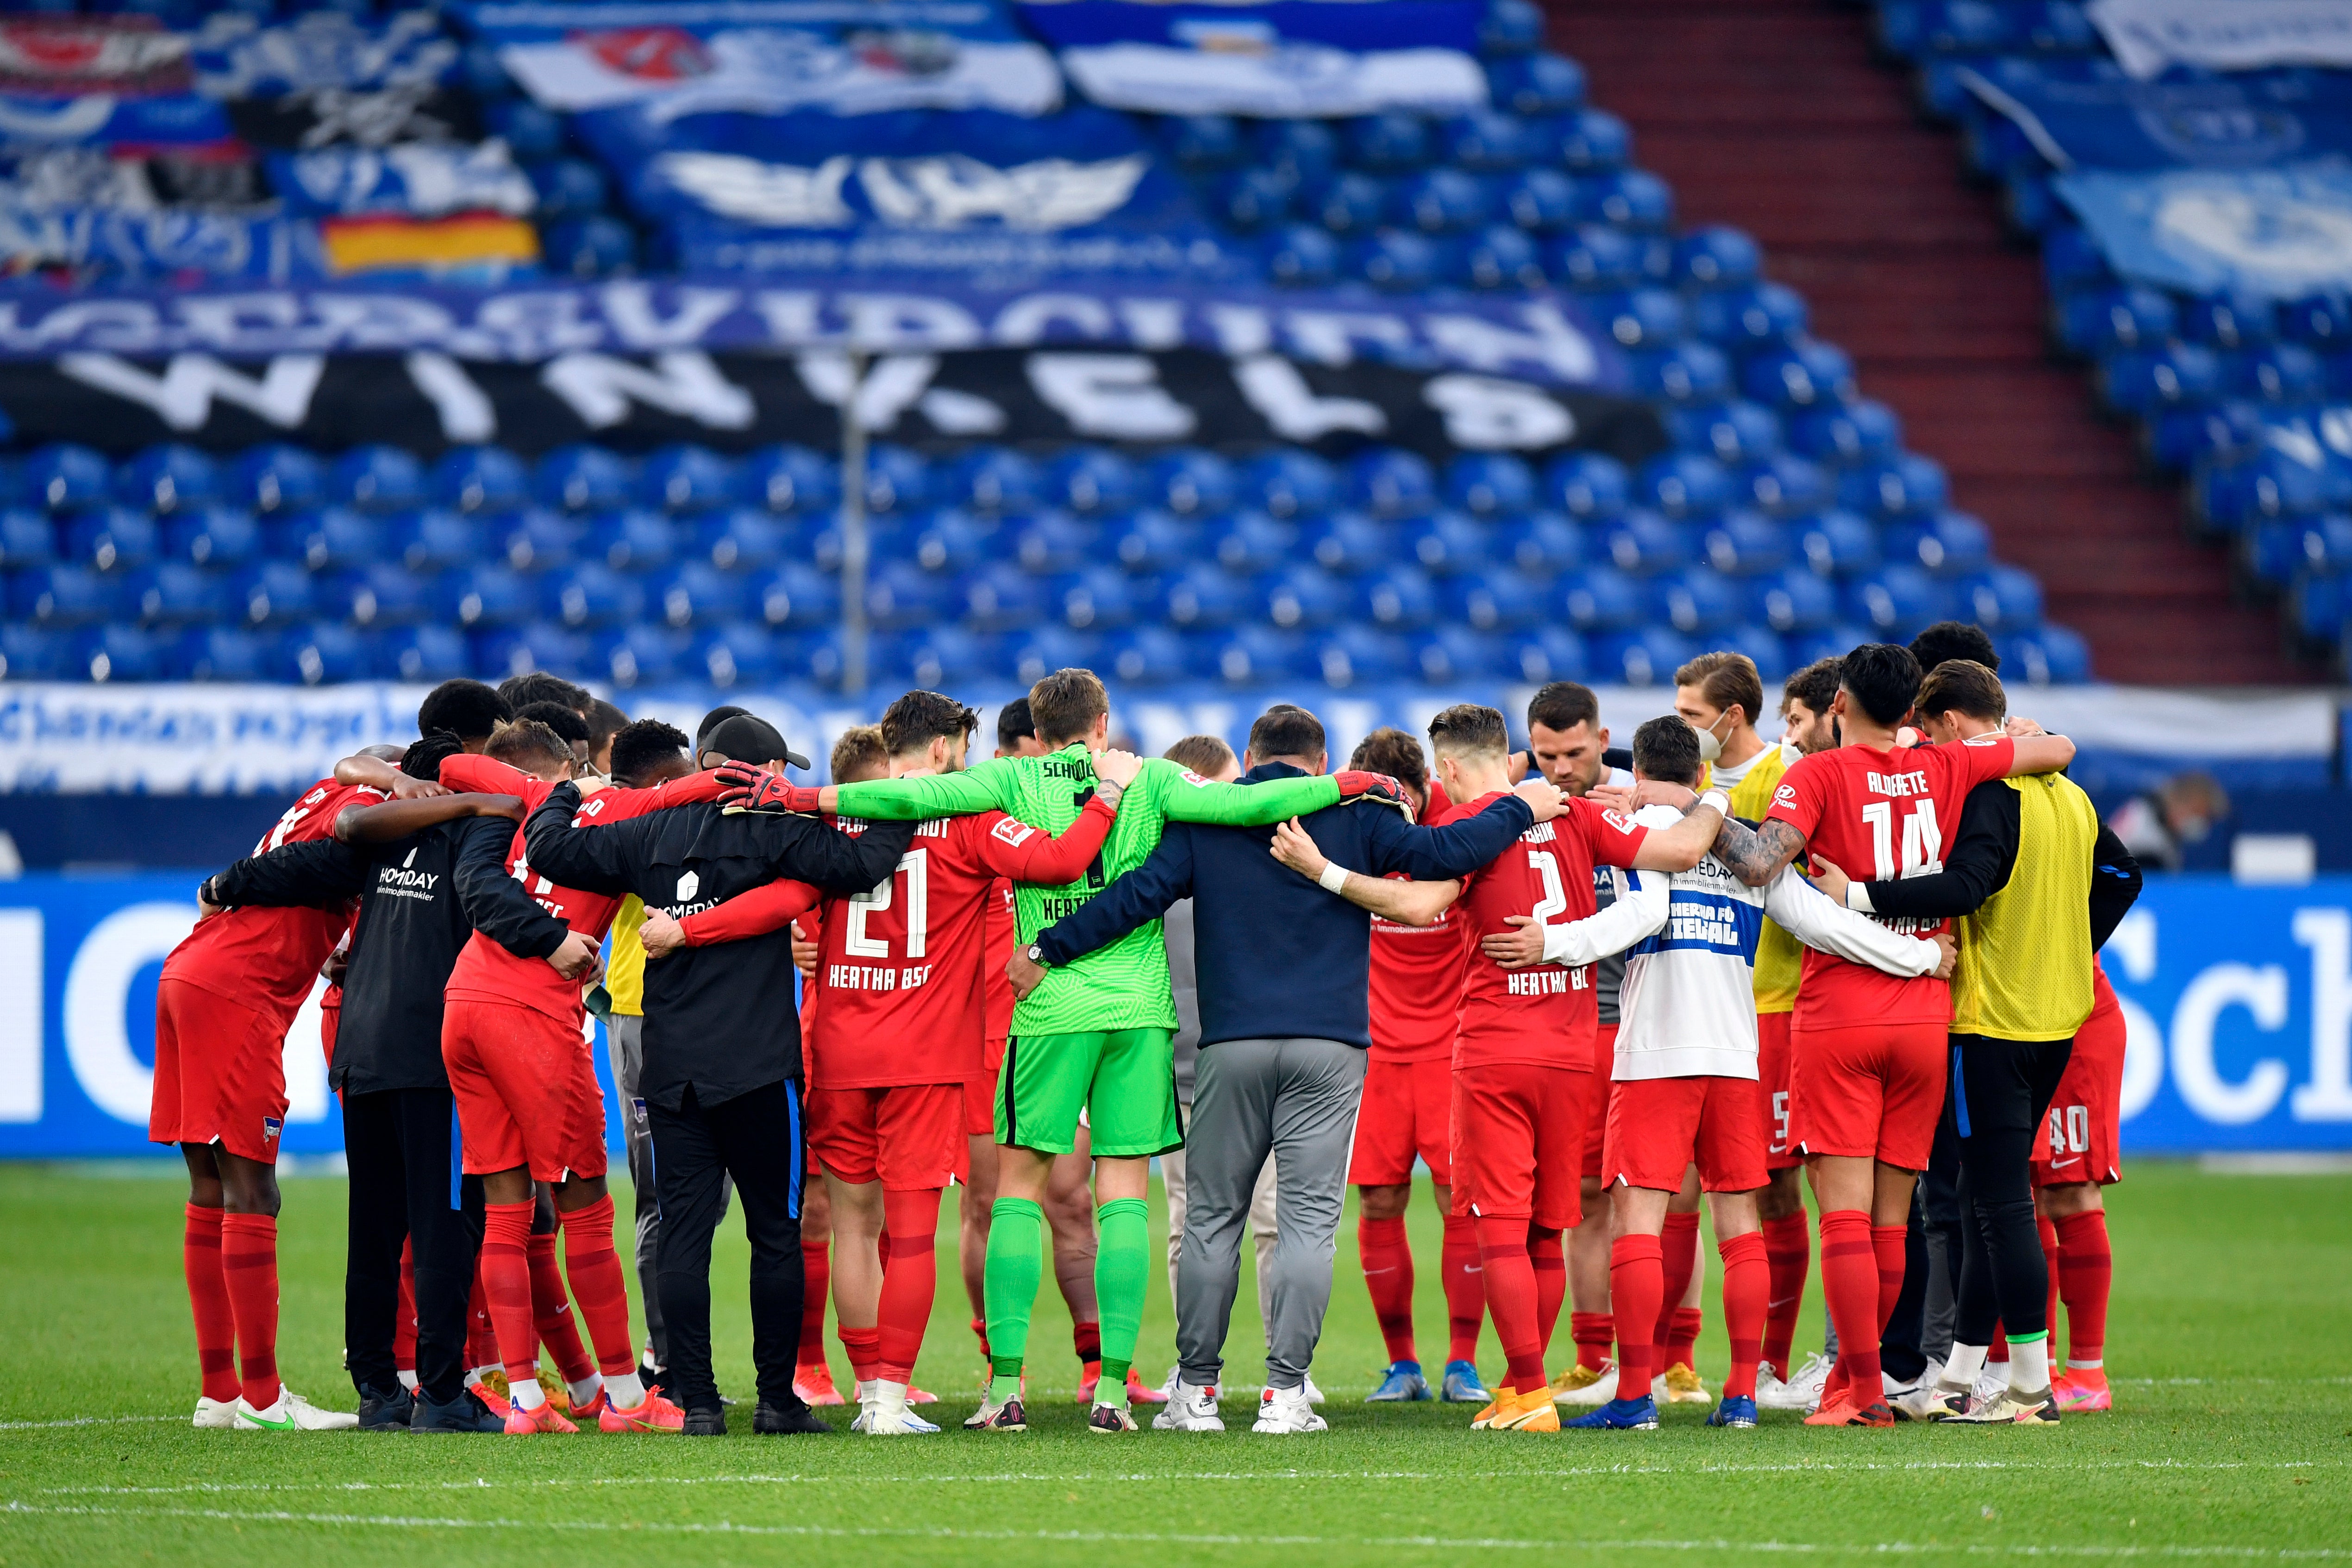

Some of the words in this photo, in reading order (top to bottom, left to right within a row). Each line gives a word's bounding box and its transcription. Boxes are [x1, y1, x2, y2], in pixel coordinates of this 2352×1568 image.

[1862, 798, 1943, 882] 14
[845, 848, 927, 958] 21
[1528, 850, 1567, 965] 2
[829, 964, 896, 991] HERTHA
[901, 964, 932, 990] BSC
[1508, 970, 1568, 995] HERTHA
[2050, 1106, 2089, 1154] 40
